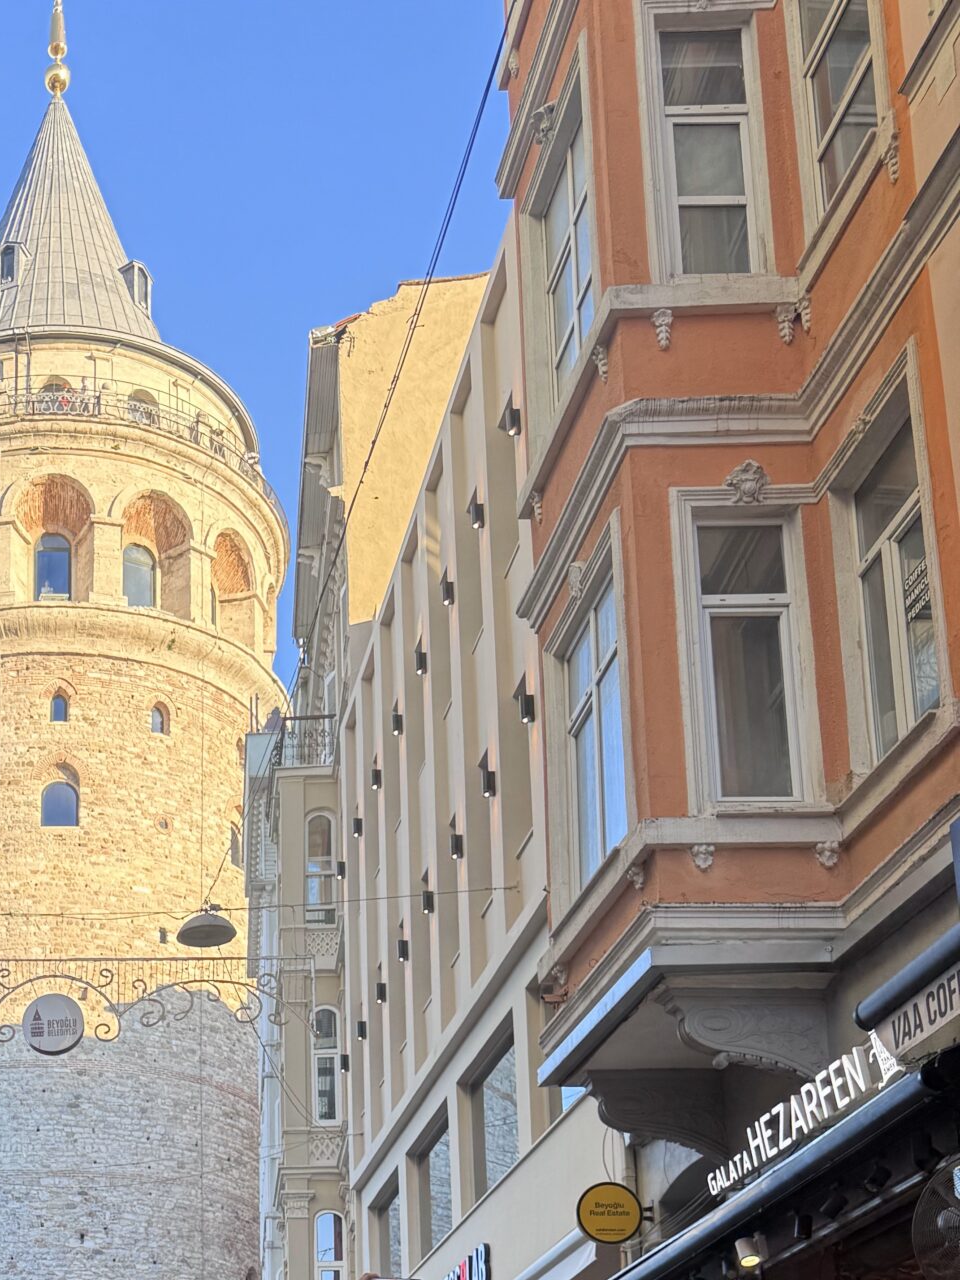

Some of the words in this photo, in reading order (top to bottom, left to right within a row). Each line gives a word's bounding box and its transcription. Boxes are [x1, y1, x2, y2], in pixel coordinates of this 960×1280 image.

[47, 1016, 77, 1029] BEYOĞLU
[891, 1001, 924, 1050] VAA
[707, 1149, 752, 1196] GALATA
[746, 1046, 867, 1168] HEZARFEN
